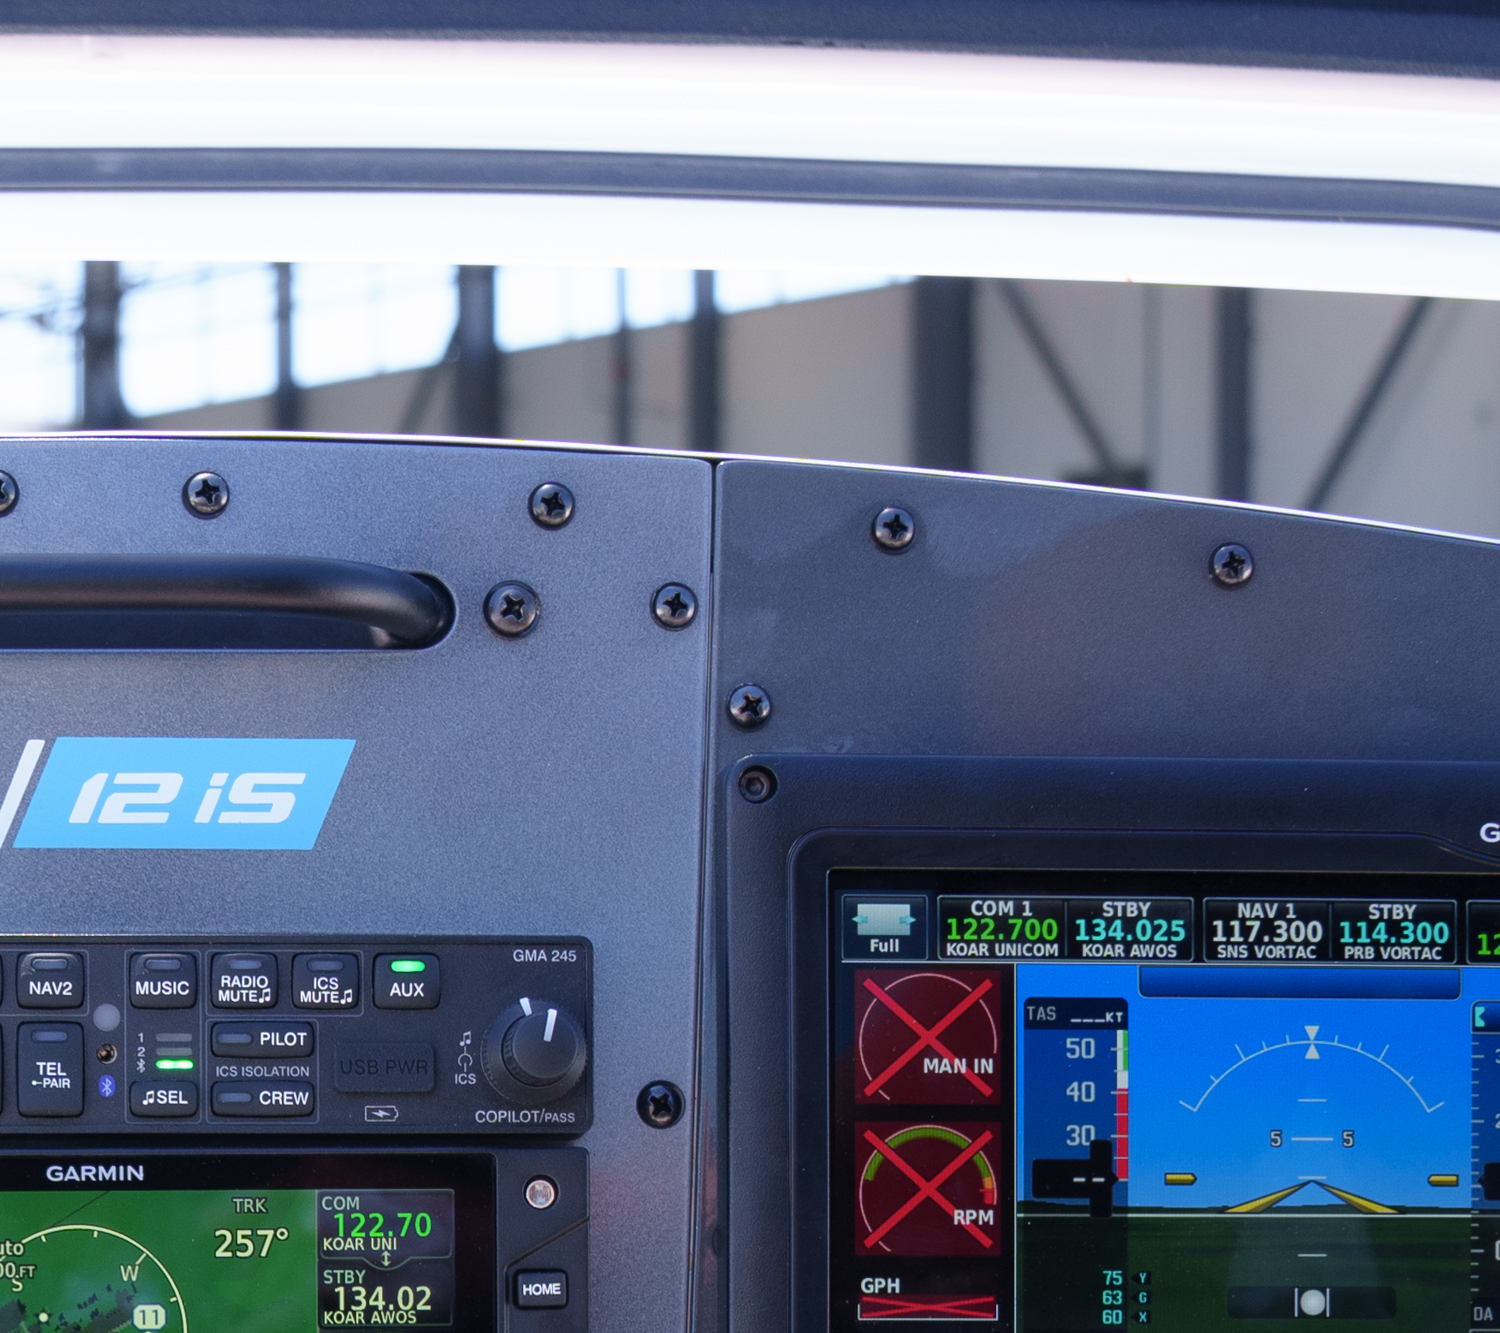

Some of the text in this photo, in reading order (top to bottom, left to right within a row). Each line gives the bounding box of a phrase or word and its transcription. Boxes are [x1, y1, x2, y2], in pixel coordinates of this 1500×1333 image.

[948, 918, 1058, 940] 122.700
[1076, 919, 1185, 941] 134.025
[869, 938, 899, 953] Full
[513, 949, 576, 962] GMA 245
[29, 982, 72, 996] NAV2
[136, 981, 189, 995] MUSIC
[390, 983, 424, 997] AUX
[261, 1032, 307, 1046] PILOT
[36, 1062, 66, 1075] TEL
[216, 1066, 309, 1077] ICS ISOLATION
[260, 1091, 308, 1105] CREW
[47, 1165, 144, 1181] GARMIN
[233, 1199, 267, 1213] TRK
[334, 1213, 431, 1237] 122.70
[523, 1283, 561, 1295] HOME
[335, 1286, 431, 1310] 134.02
